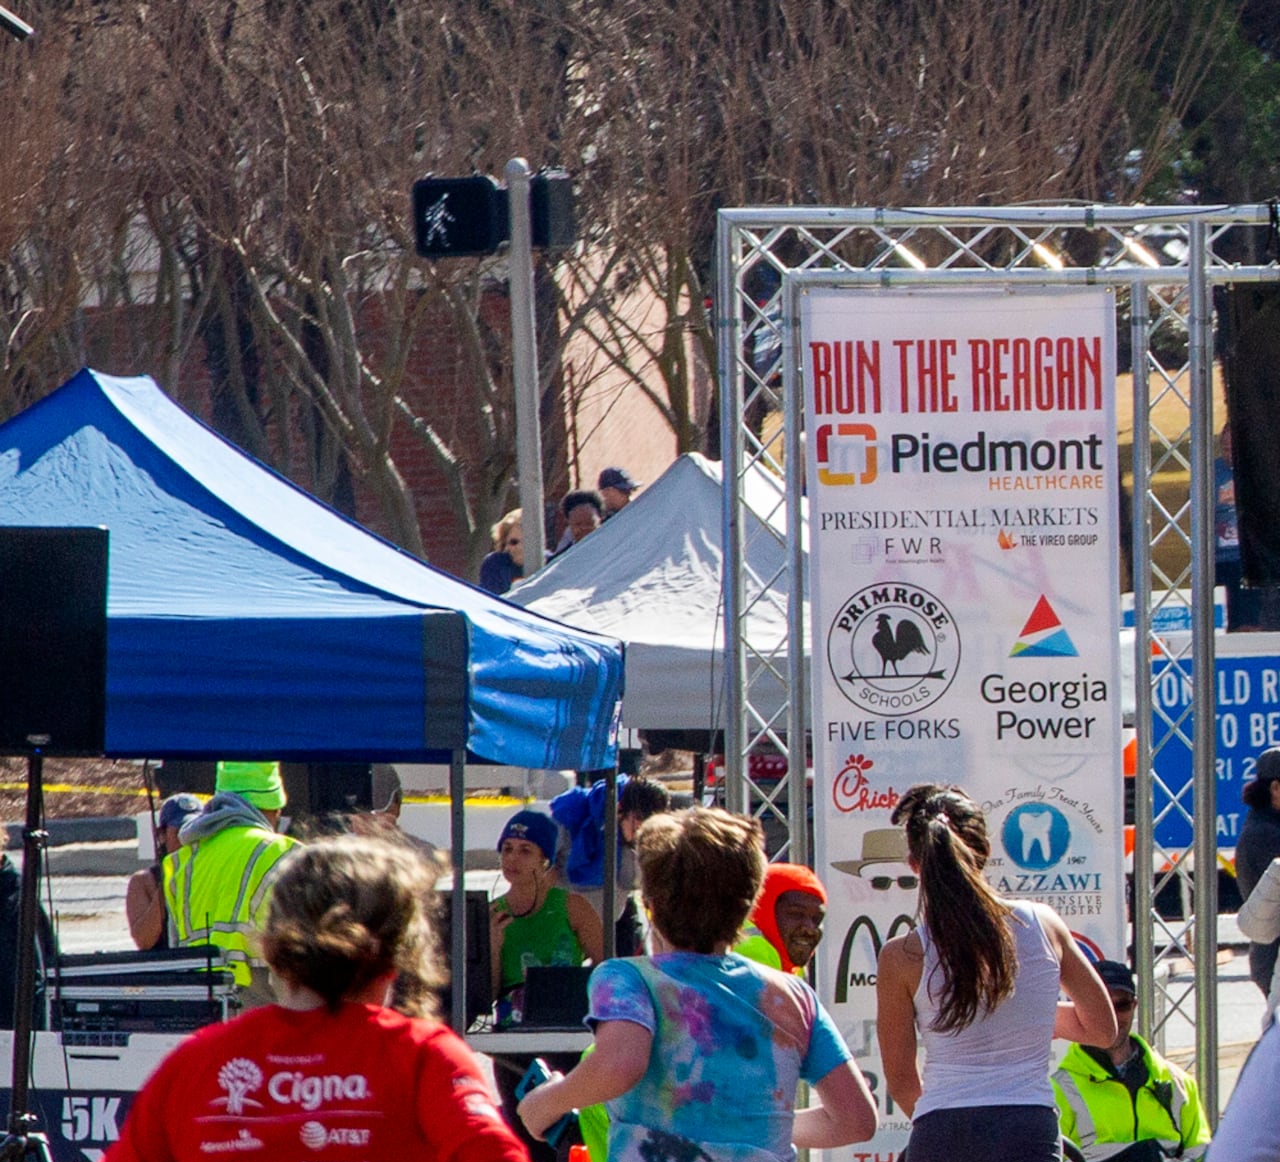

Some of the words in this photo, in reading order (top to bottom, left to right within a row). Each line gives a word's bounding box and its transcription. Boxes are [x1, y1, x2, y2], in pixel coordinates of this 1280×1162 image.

[809, 340, 880, 415] RUN
[893, 340, 957, 413] THE
[968, 337, 1103, 412] REAGAN
[891, 429, 1104, 474] Piedmont
[988, 475, 1104, 490] HEALTHCARE
[821, 510, 987, 530] PRESIDENTIAL
[991, 507, 1099, 527] MARKETS
[1021, 535, 1037, 546] THE
[1039, 535, 1066, 546] VIREO
[1068, 535, 1098, 546] GROUP
[838, 586, 950, 634] PRIMROSE
[858, 685, 932, 709] SCHOOLS
[980, 674, 1107, 709] Georgia
[828, 721, 875, 742] FIVE
[885, 718, 961, 741] FORKS
[996, 711, 1096, 740] Power
[1250, 711, 1280, 748] BE
[1005, 785, 1046, 801] Family
[985, 873, 1102, 893] AZZAWI
[267, 1071, 367, 1111] Cigna
[61, 1096, 122, 1141] 5K
[327, 1128, 371, 1145] AT&T
